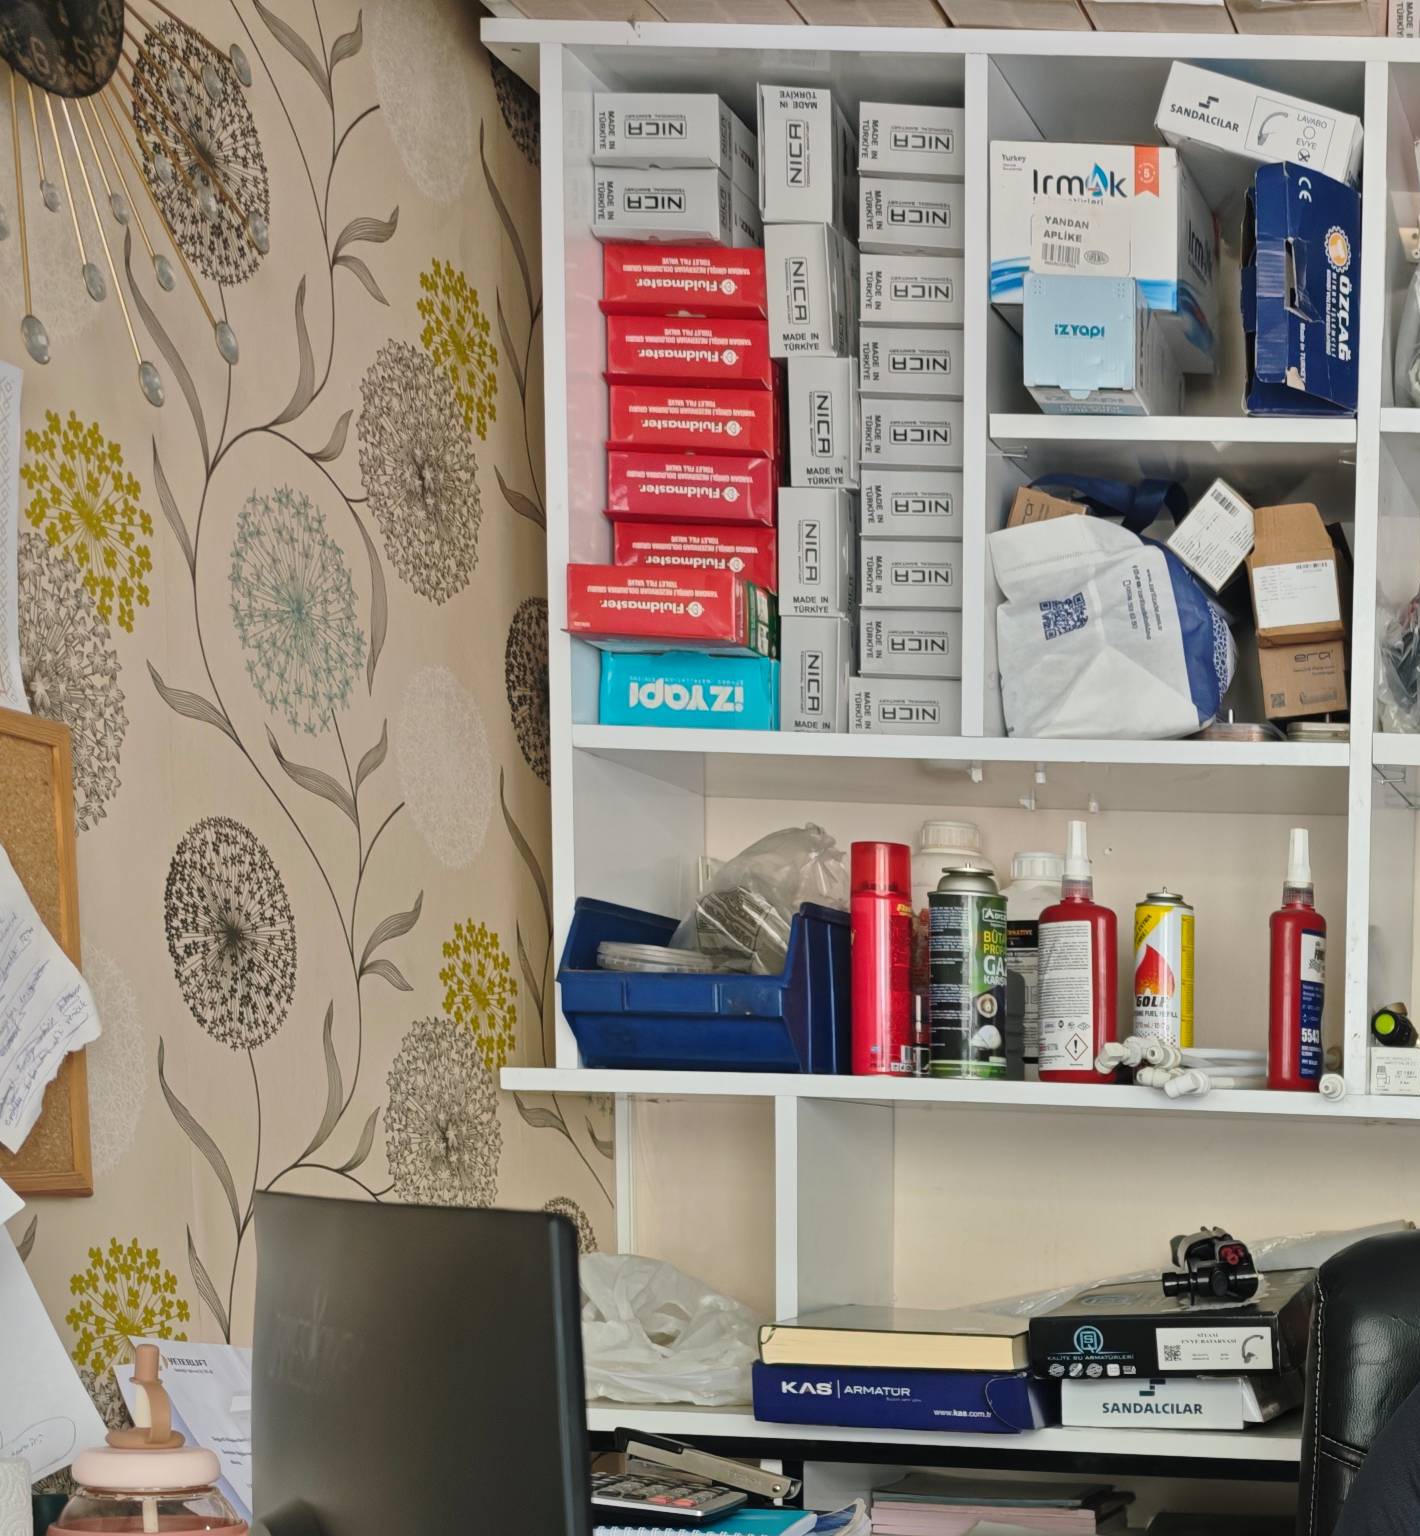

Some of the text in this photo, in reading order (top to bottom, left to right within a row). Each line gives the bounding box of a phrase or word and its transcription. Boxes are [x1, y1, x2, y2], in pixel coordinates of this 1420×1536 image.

[780, 90, 816, 99] TÜRKİYE
[795, 101, 818, 109] MADE
[1170, 104, 1239, 132] SANDALCILAR
[1297, 114, 1327, 128] LAVABO
[628, 122, 684, 135] NICA
[861, 120, 870, 158] TÜRKİYE
[871, 120, 879, 159] MADE IN
[894, 136, 950, 150] NICA
[1296, 138, 1317, 150] EVYE
[789, 123, 803, 183] NICA
[597, 182, 605, 220] TÜRKİYE
[627, 196, 683, 210] NICA
[607, 211, 613, 220] IN
[865, 191, 873, 229] TÜRKİYE
[891, 210, 947, 224] NICA
[1045, 216, 1089, 229] YANDAN
[1044, 230, 1082, 242] APLİKE
[791, 261, 806, 321] NICA
[865, 271, 873, 310] TÜRKİYE
[894, 285, 950, 298] NICA
[874, 302, 881, 310] IN
[1336, 274, 1352, 361] ÖZÇAĞ
[783, 333, 806, 341] MADE
[784, 341, 819, 351] TÜRKİYE
[892, 357, 948, 371] NICA
[872, 373, 879, 381] IN
[816, 395, 831, 454] NICA
[864, 415, 872, 453] TÜRKİYE
[893, 428, 948, 442] NICA
[835, 467, 843, 475] IN
[808, 475, 844, 485] TÜRKİYE
[867, 486, 875, 523] TÜRKİYE
[895, 500, 950, 513] NICA
[805, 524, 818, 582] NICA
[894, 570, 949, 583] NICA
[794, 604, 828, 613] TÜRKİYE
[874, 621, 882, 641] MADE
[891, 639, 945, 652] NICA
[807, 654, 820, 712] NICA
[882, 708, 936, 721] NICA
[795, 721, 818, 729] MADE
[865, 721, 871, 729] IN
[983, 956, 1007, 976] GA
[934, 1409, 992, 1418] www.kas.com.tr
[1102, 1402, 1203, 1415] SANDALCILAR
